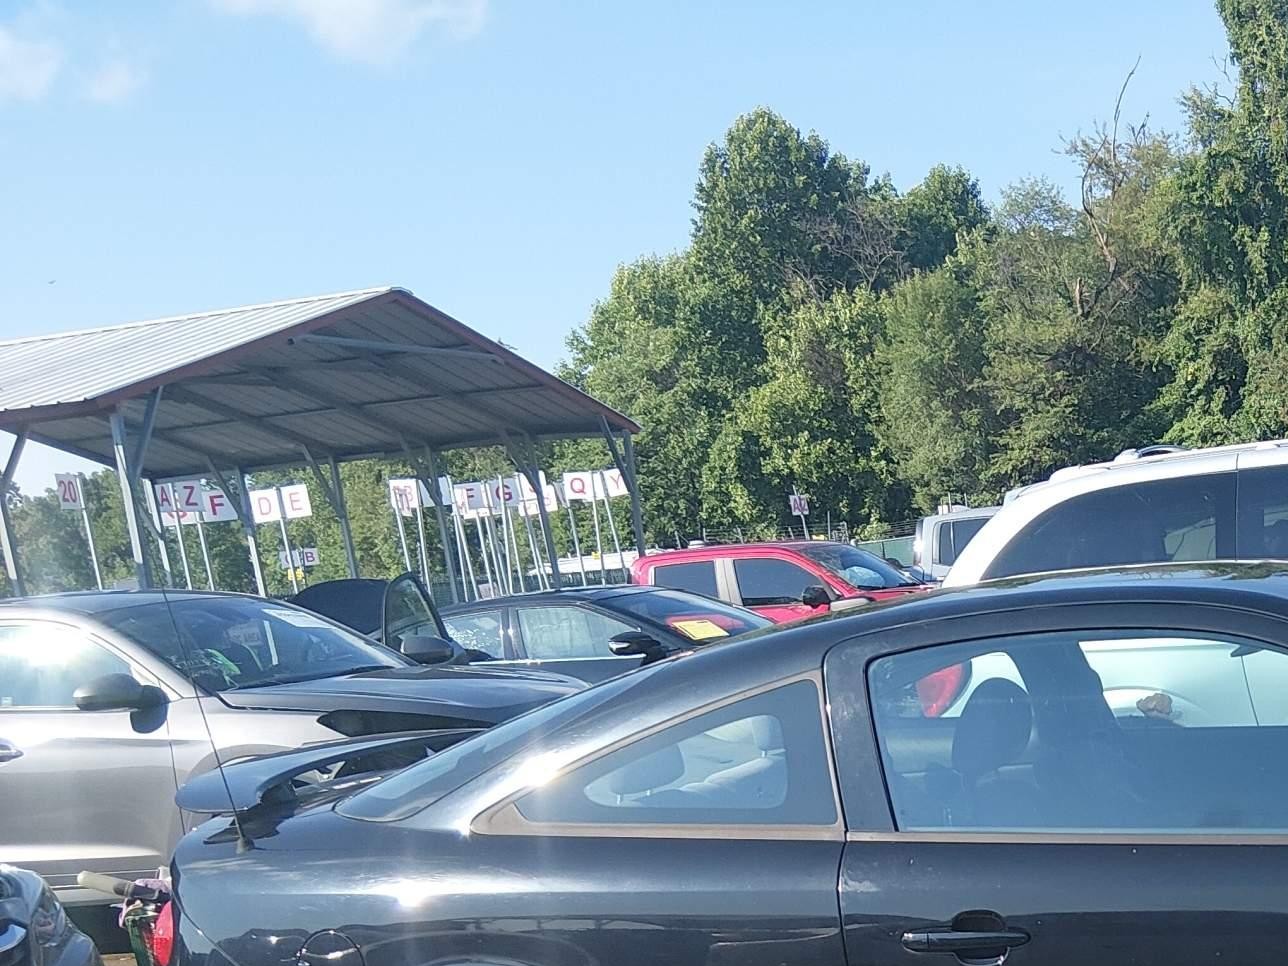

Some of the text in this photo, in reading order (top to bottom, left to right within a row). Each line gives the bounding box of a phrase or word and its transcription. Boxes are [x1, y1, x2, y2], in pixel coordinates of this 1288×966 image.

[570, 477, 586, 495] Q
[609, 473, 621, 490] Y
[58, 480, 77, 503] 20
[160, 486, 171, 506] A
[183, 485, 198, 506] Z
[495, 484, 513, 502] G
[209, 494, 224, 515] F
[258, 497, 272, 515] D
[289, 492, 303, 511] E
[304, 551, 316, 563] B
